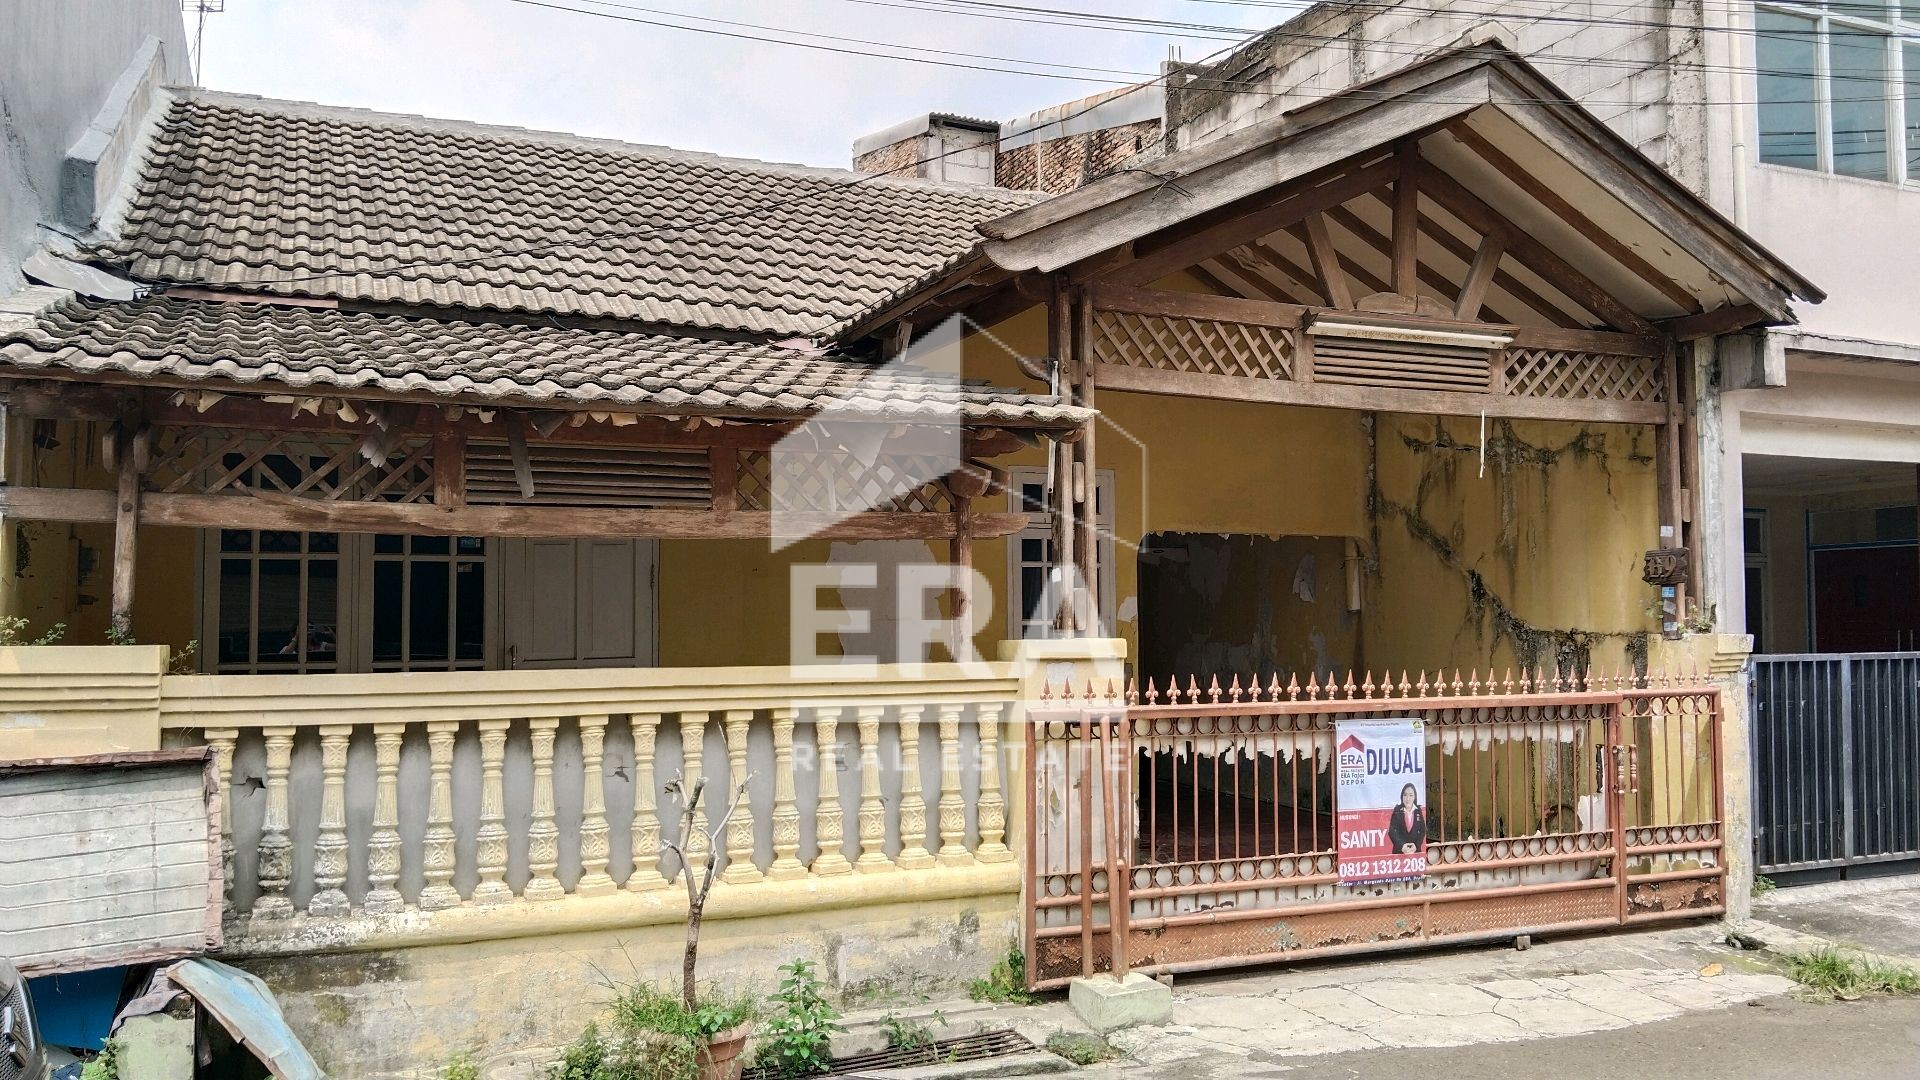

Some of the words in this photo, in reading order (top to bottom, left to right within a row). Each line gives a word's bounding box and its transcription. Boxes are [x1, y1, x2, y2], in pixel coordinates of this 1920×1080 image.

[1340, 754, 1364, 765] ERA
[1366, 747, 1423, 775] DIJUAL
[1340, 829, 1388, 849] SANTY
[1340, 861, 1369, 877] 0812
[1372, 859, 1401, 875] 1312
[1403, 857, 1426, 873] 208
